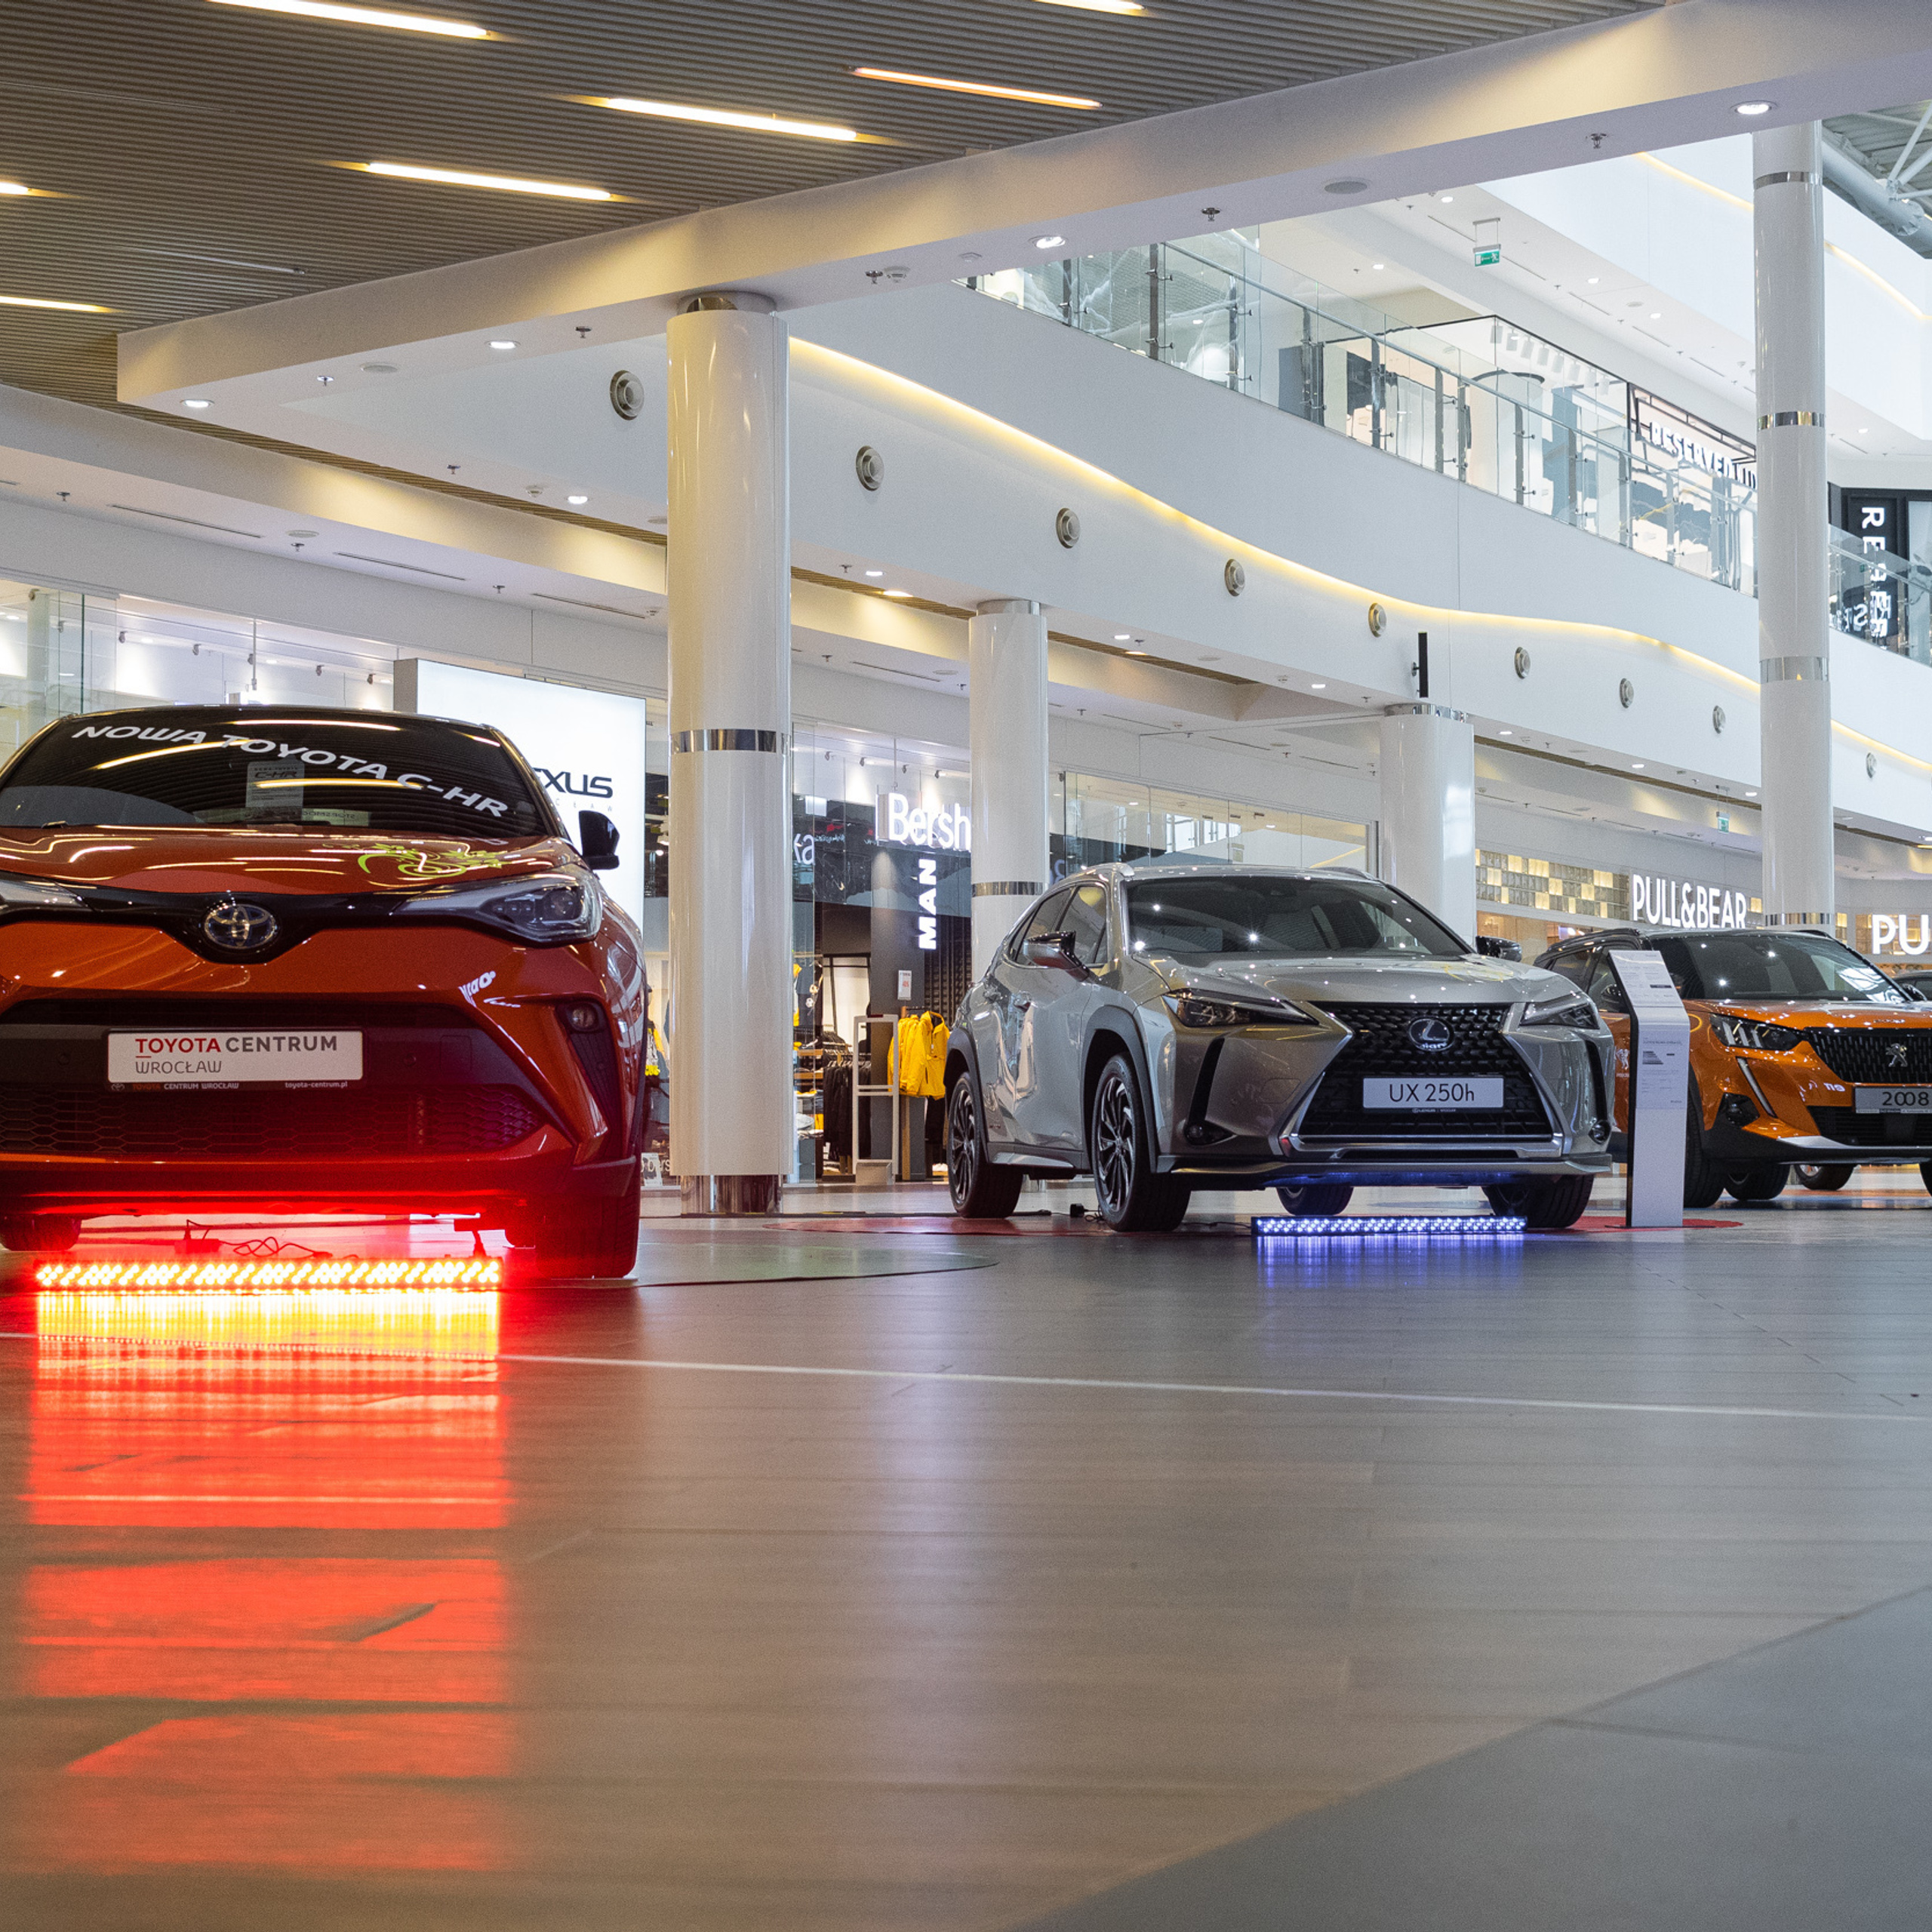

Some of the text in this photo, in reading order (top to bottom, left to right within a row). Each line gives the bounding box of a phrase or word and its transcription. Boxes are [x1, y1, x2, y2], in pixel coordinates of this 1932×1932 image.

[1650, 421, 1734, 480] RESERVED
[72, 726, 509, 817] NOWA TOYOTA C-HR
[888, 792, 971, 851] Bersh
[918, 859, 937, 950] MAN
[1633, 874, 1747, 929] PULL&BEAR
[1872, 914, 1929, 955] PU
[135, 1035, 337, 1054] TOYOTA CENTRUM
[135, 1060, 222, 1075] WROCŁAW
[132, 1083, 162, 1091] TOYOTA
[202, 1081, 239, 1090] WROCŁAW
[285, 1081, 348, 1090] toyota-centrum.pl
[1389, 1083, 1475, 1102] UX 250h
[1882, 1091, 1930, 1106] 2008
